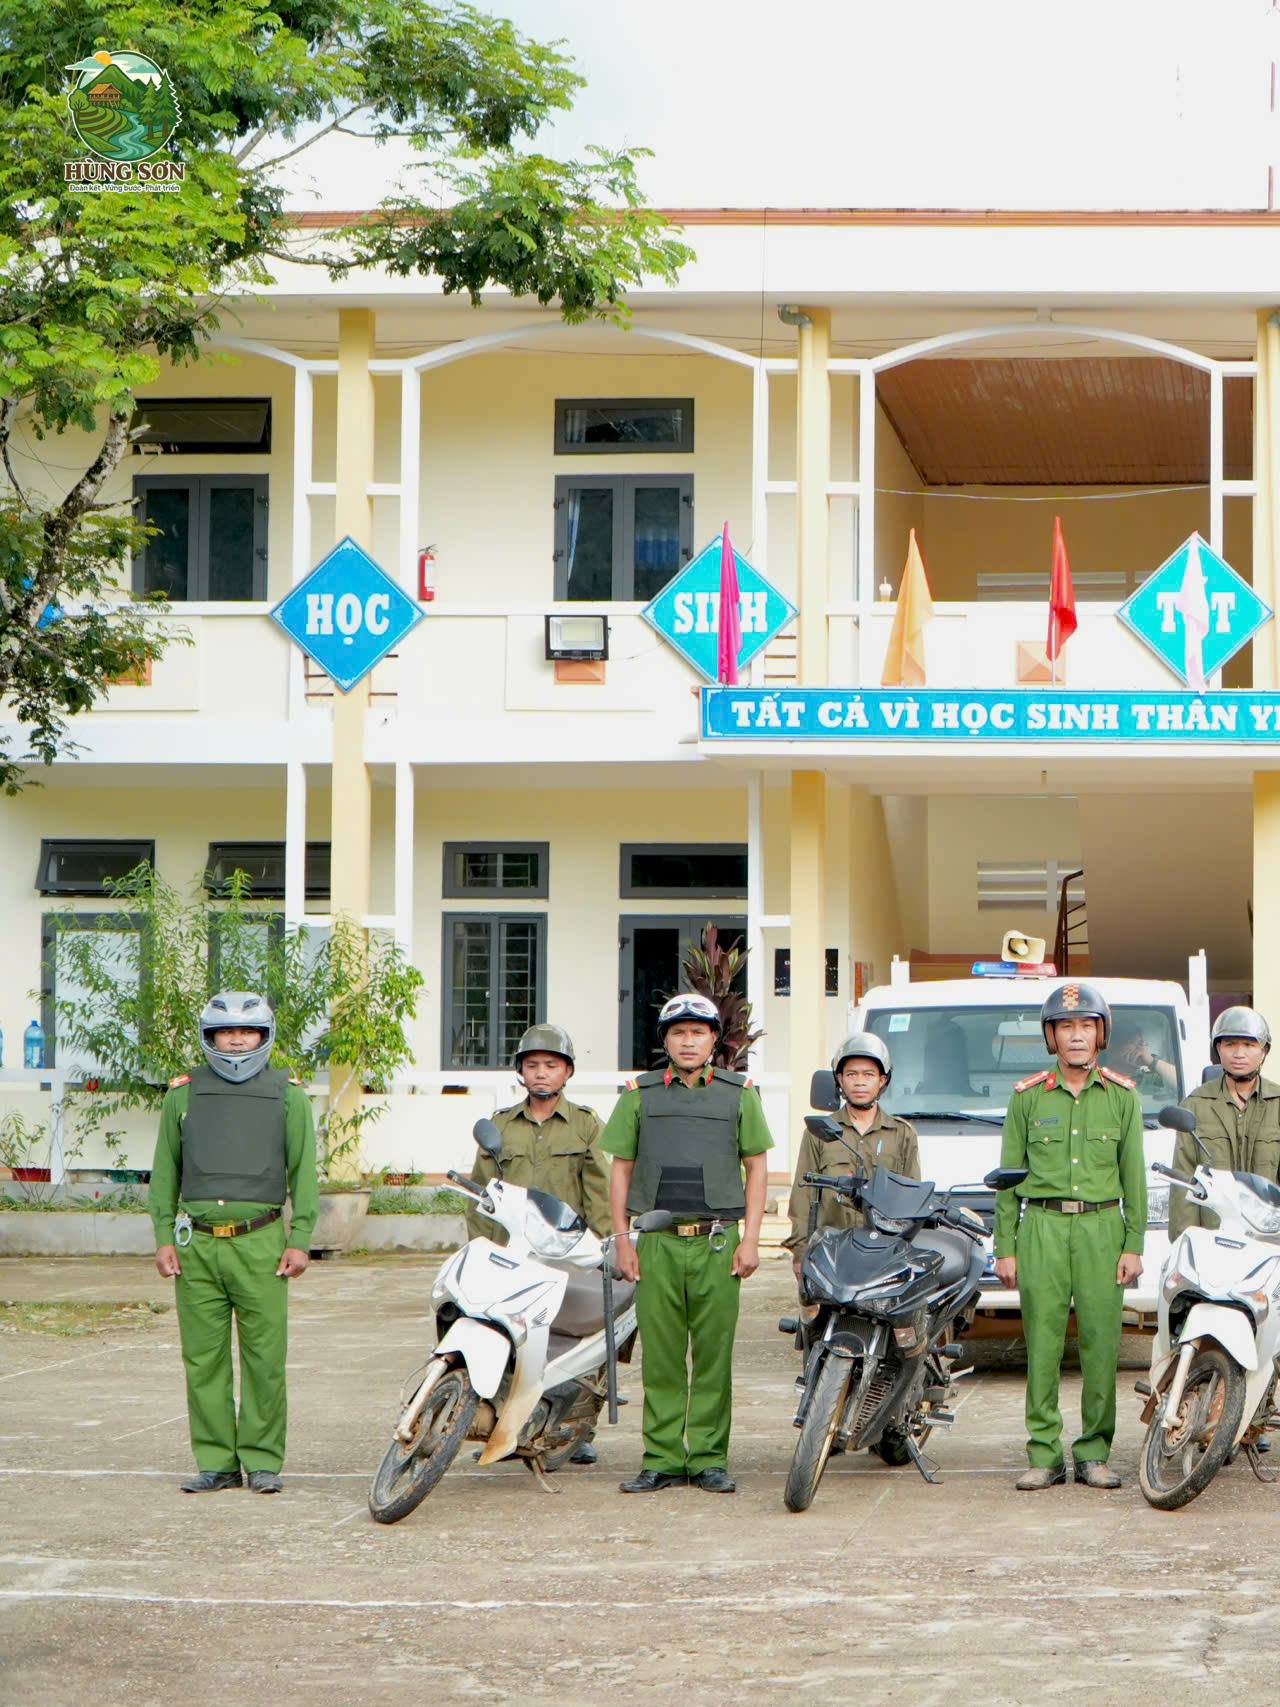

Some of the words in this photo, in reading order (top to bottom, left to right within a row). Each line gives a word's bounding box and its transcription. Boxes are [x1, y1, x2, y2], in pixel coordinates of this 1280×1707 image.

[306, 593, 390, 645] HỌC
[1157, 576, 1235, 632] TT
[731, 692, 806, 728] TẤT
[817, 695, 869, 729] CẢ
[879, 696, 920, 729] VÌ
[931, 702, 1015, 735] HỌC
[1026, 703, 1120, 730] SINH
[1130, 699, 1238, 731] THÂN
